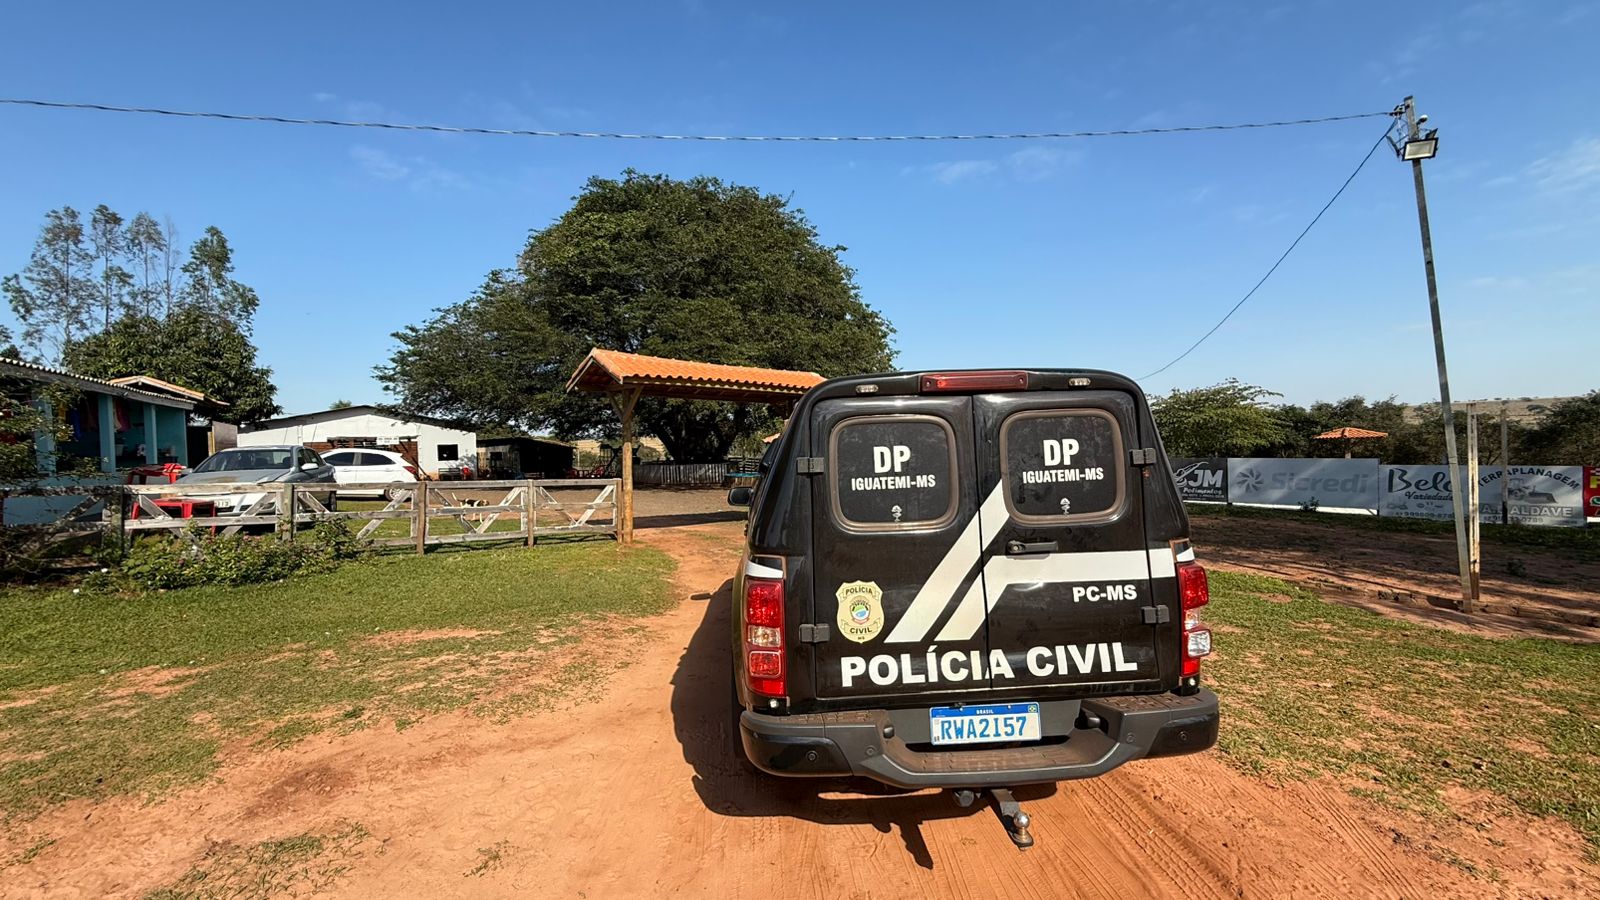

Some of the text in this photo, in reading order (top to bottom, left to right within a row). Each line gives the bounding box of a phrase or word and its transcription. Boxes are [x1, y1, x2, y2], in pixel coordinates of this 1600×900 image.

[873, 445, 911, 474] DP
[1043, 438, 1080, 466] DP
[851, 474, 936, 491] IGUATEMI-MS
[1022, 467, 1104, 484] IGUATEMI-MS
[1188, 470, 1223, 487] JM
[1271, 473, 1369, 493] Sicredi
[846, 586, 873, 596] POLÍCIA
[1072, 584, 1137, 602] PC-MS
[840, 642, 1138, 688] POLÍCIA CIVIL
